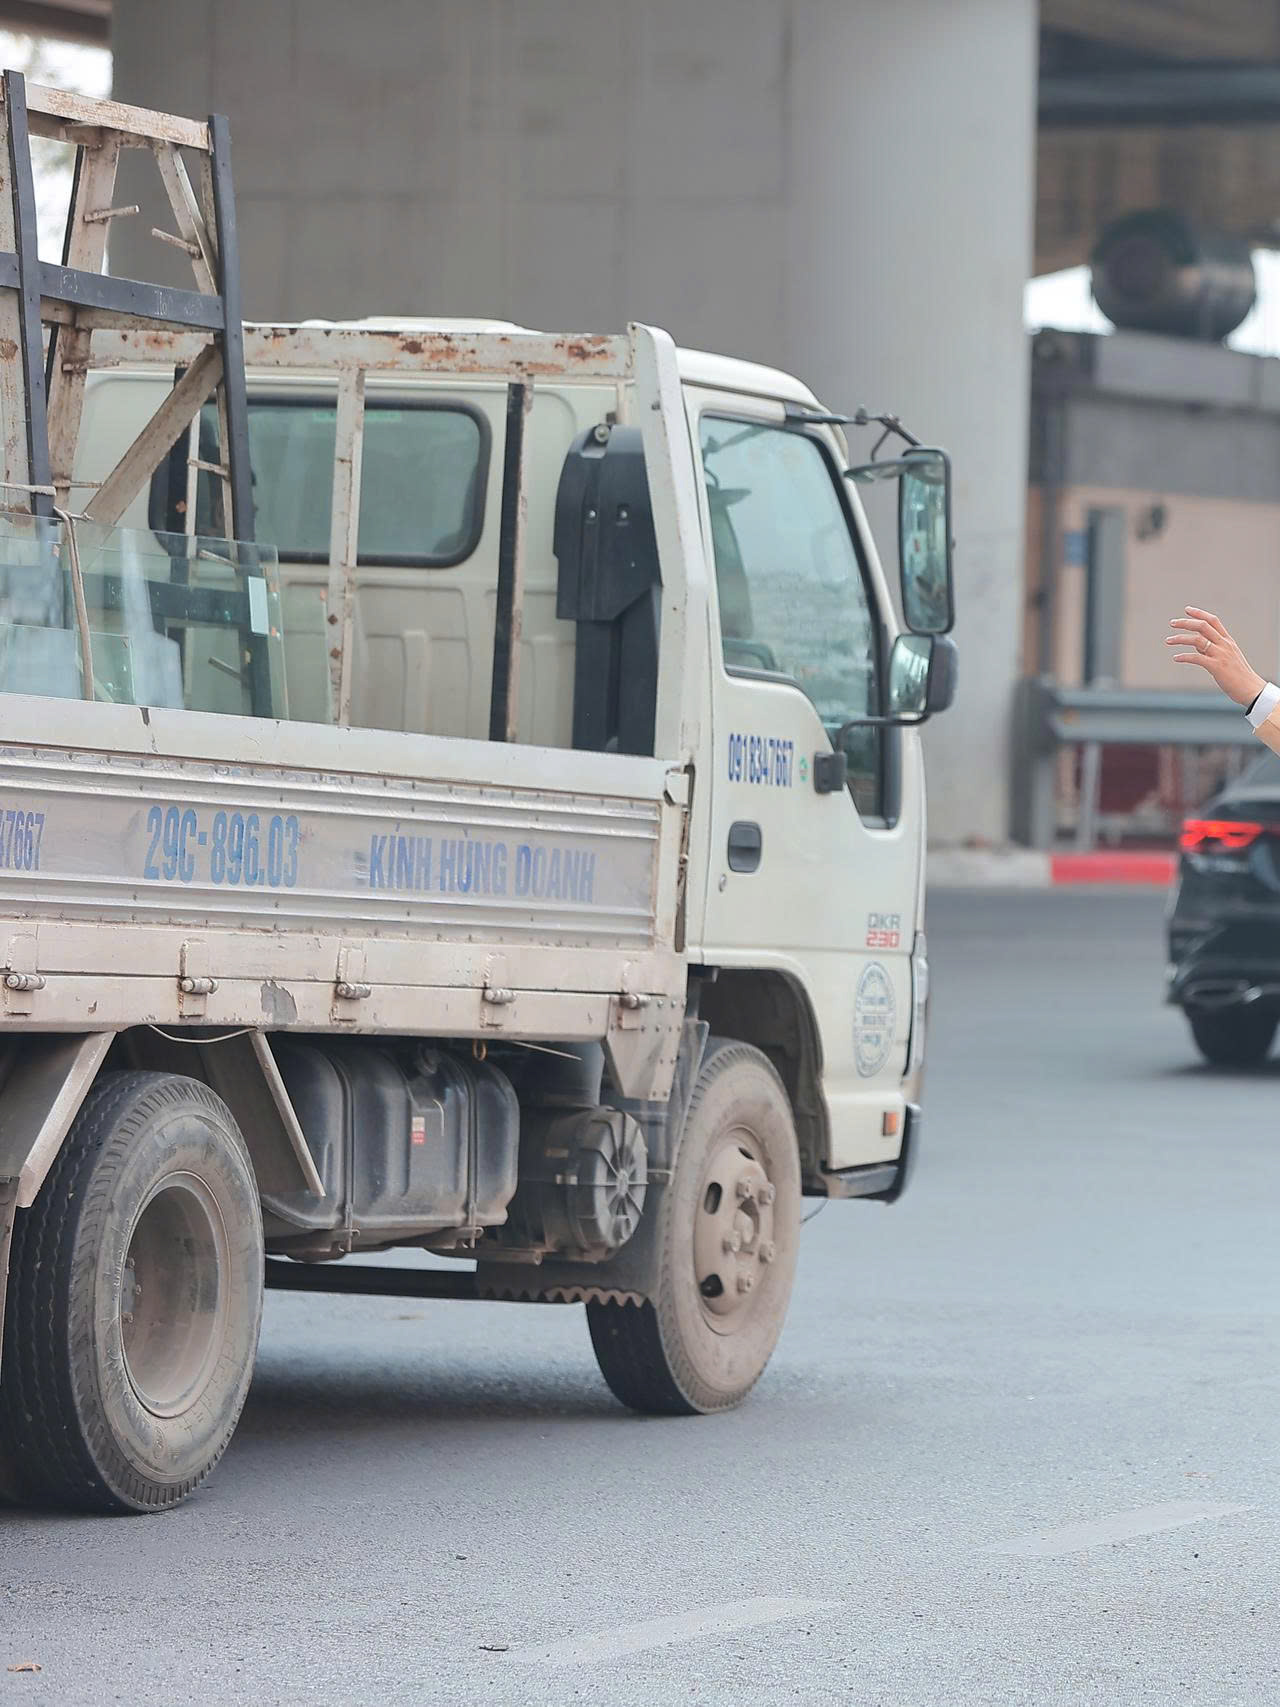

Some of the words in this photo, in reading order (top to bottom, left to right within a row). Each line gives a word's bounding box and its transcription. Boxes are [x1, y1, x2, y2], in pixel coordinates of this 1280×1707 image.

[728, 732, 794, 788] 0918347667
[143, 805, 299, 888] 29C-896.03
[515, 843, 598, 903] DOANH
[866, 930, 901, 948] 230
